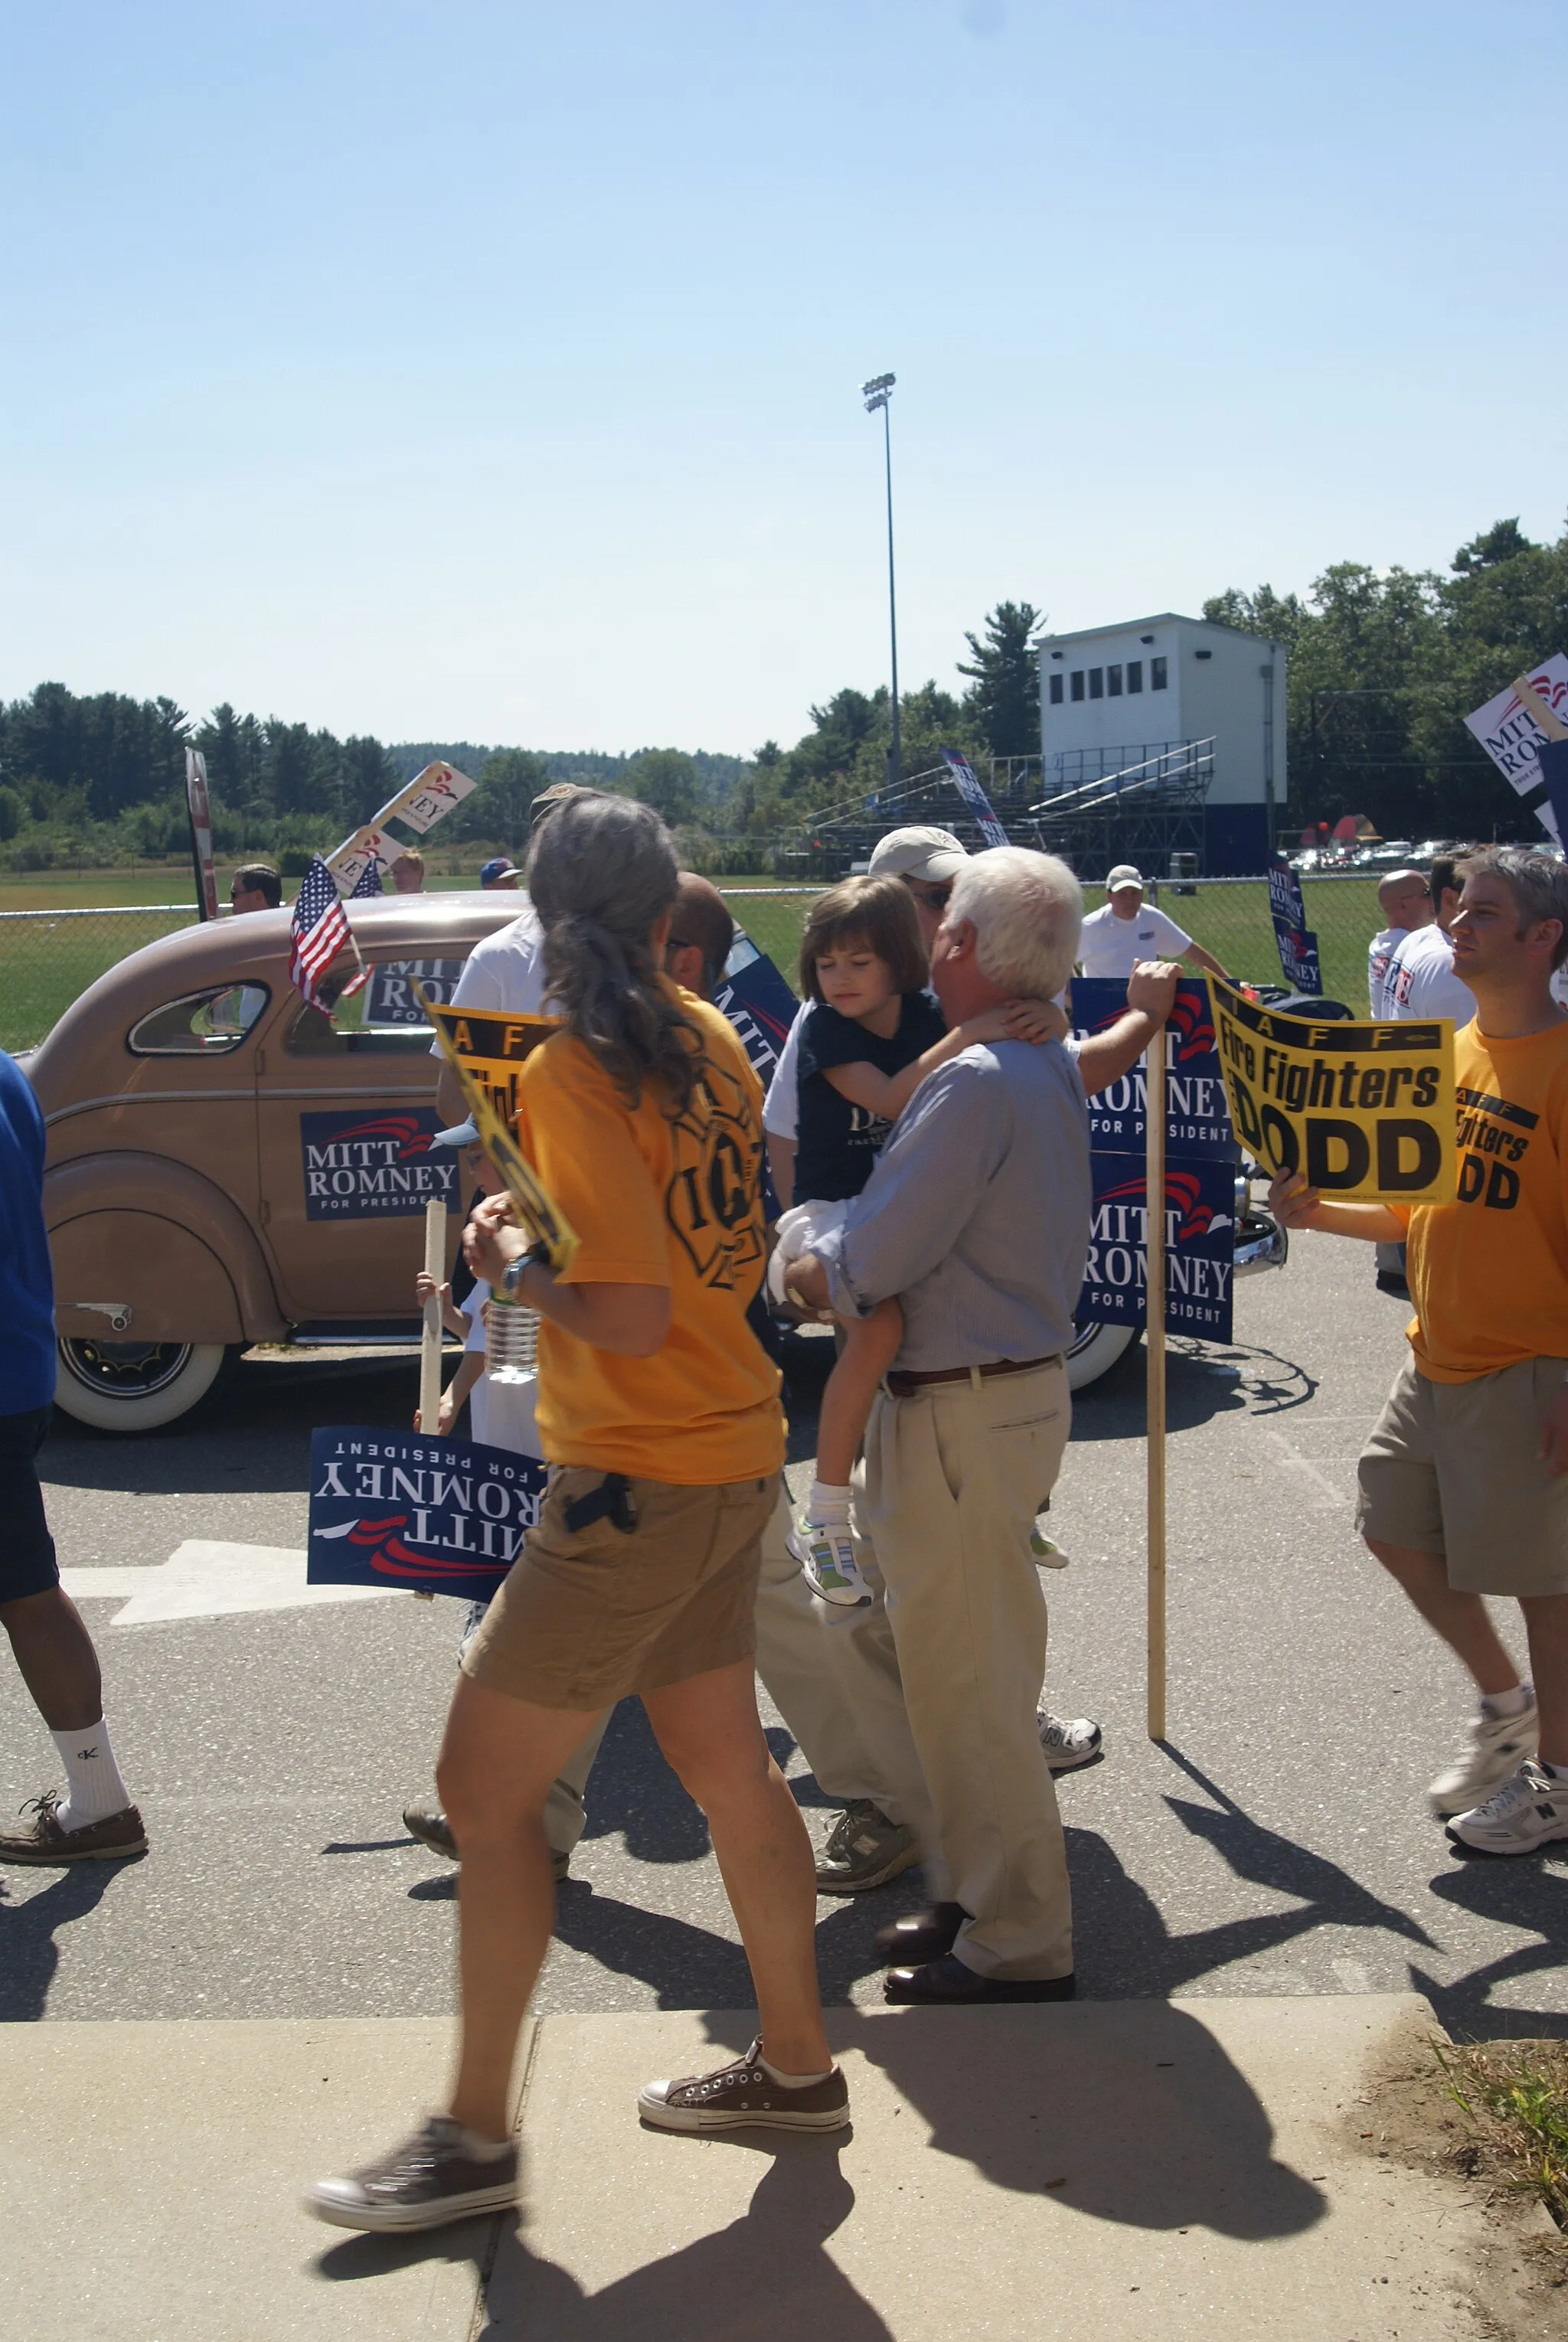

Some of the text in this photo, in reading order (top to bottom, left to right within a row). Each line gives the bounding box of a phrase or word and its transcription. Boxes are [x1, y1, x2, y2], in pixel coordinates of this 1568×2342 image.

[1485, 708, 1539, 756] MIT
[714, 985, 779, 1073] MIT
[1220, 1011, 1256, 1083] Fire
[1263, 1044, 1439, 1113] Fighters
[1090, 1119, 1229, 1142] FOR PSIDENT
[1233, 1072, 1442, 1191] DODD
[306, 1140, 400, 1169] MITT
[307, 1164, 457, 1197] ROMNEY
[321, 1199, 350, 1210] FOR
[1090, 1291, 1222, 1325] FOR PSIDENT
[335, 1441, 528, 1484] FOR PRESIDENT
[313, 1461, 541, 1527] ROMNEY
